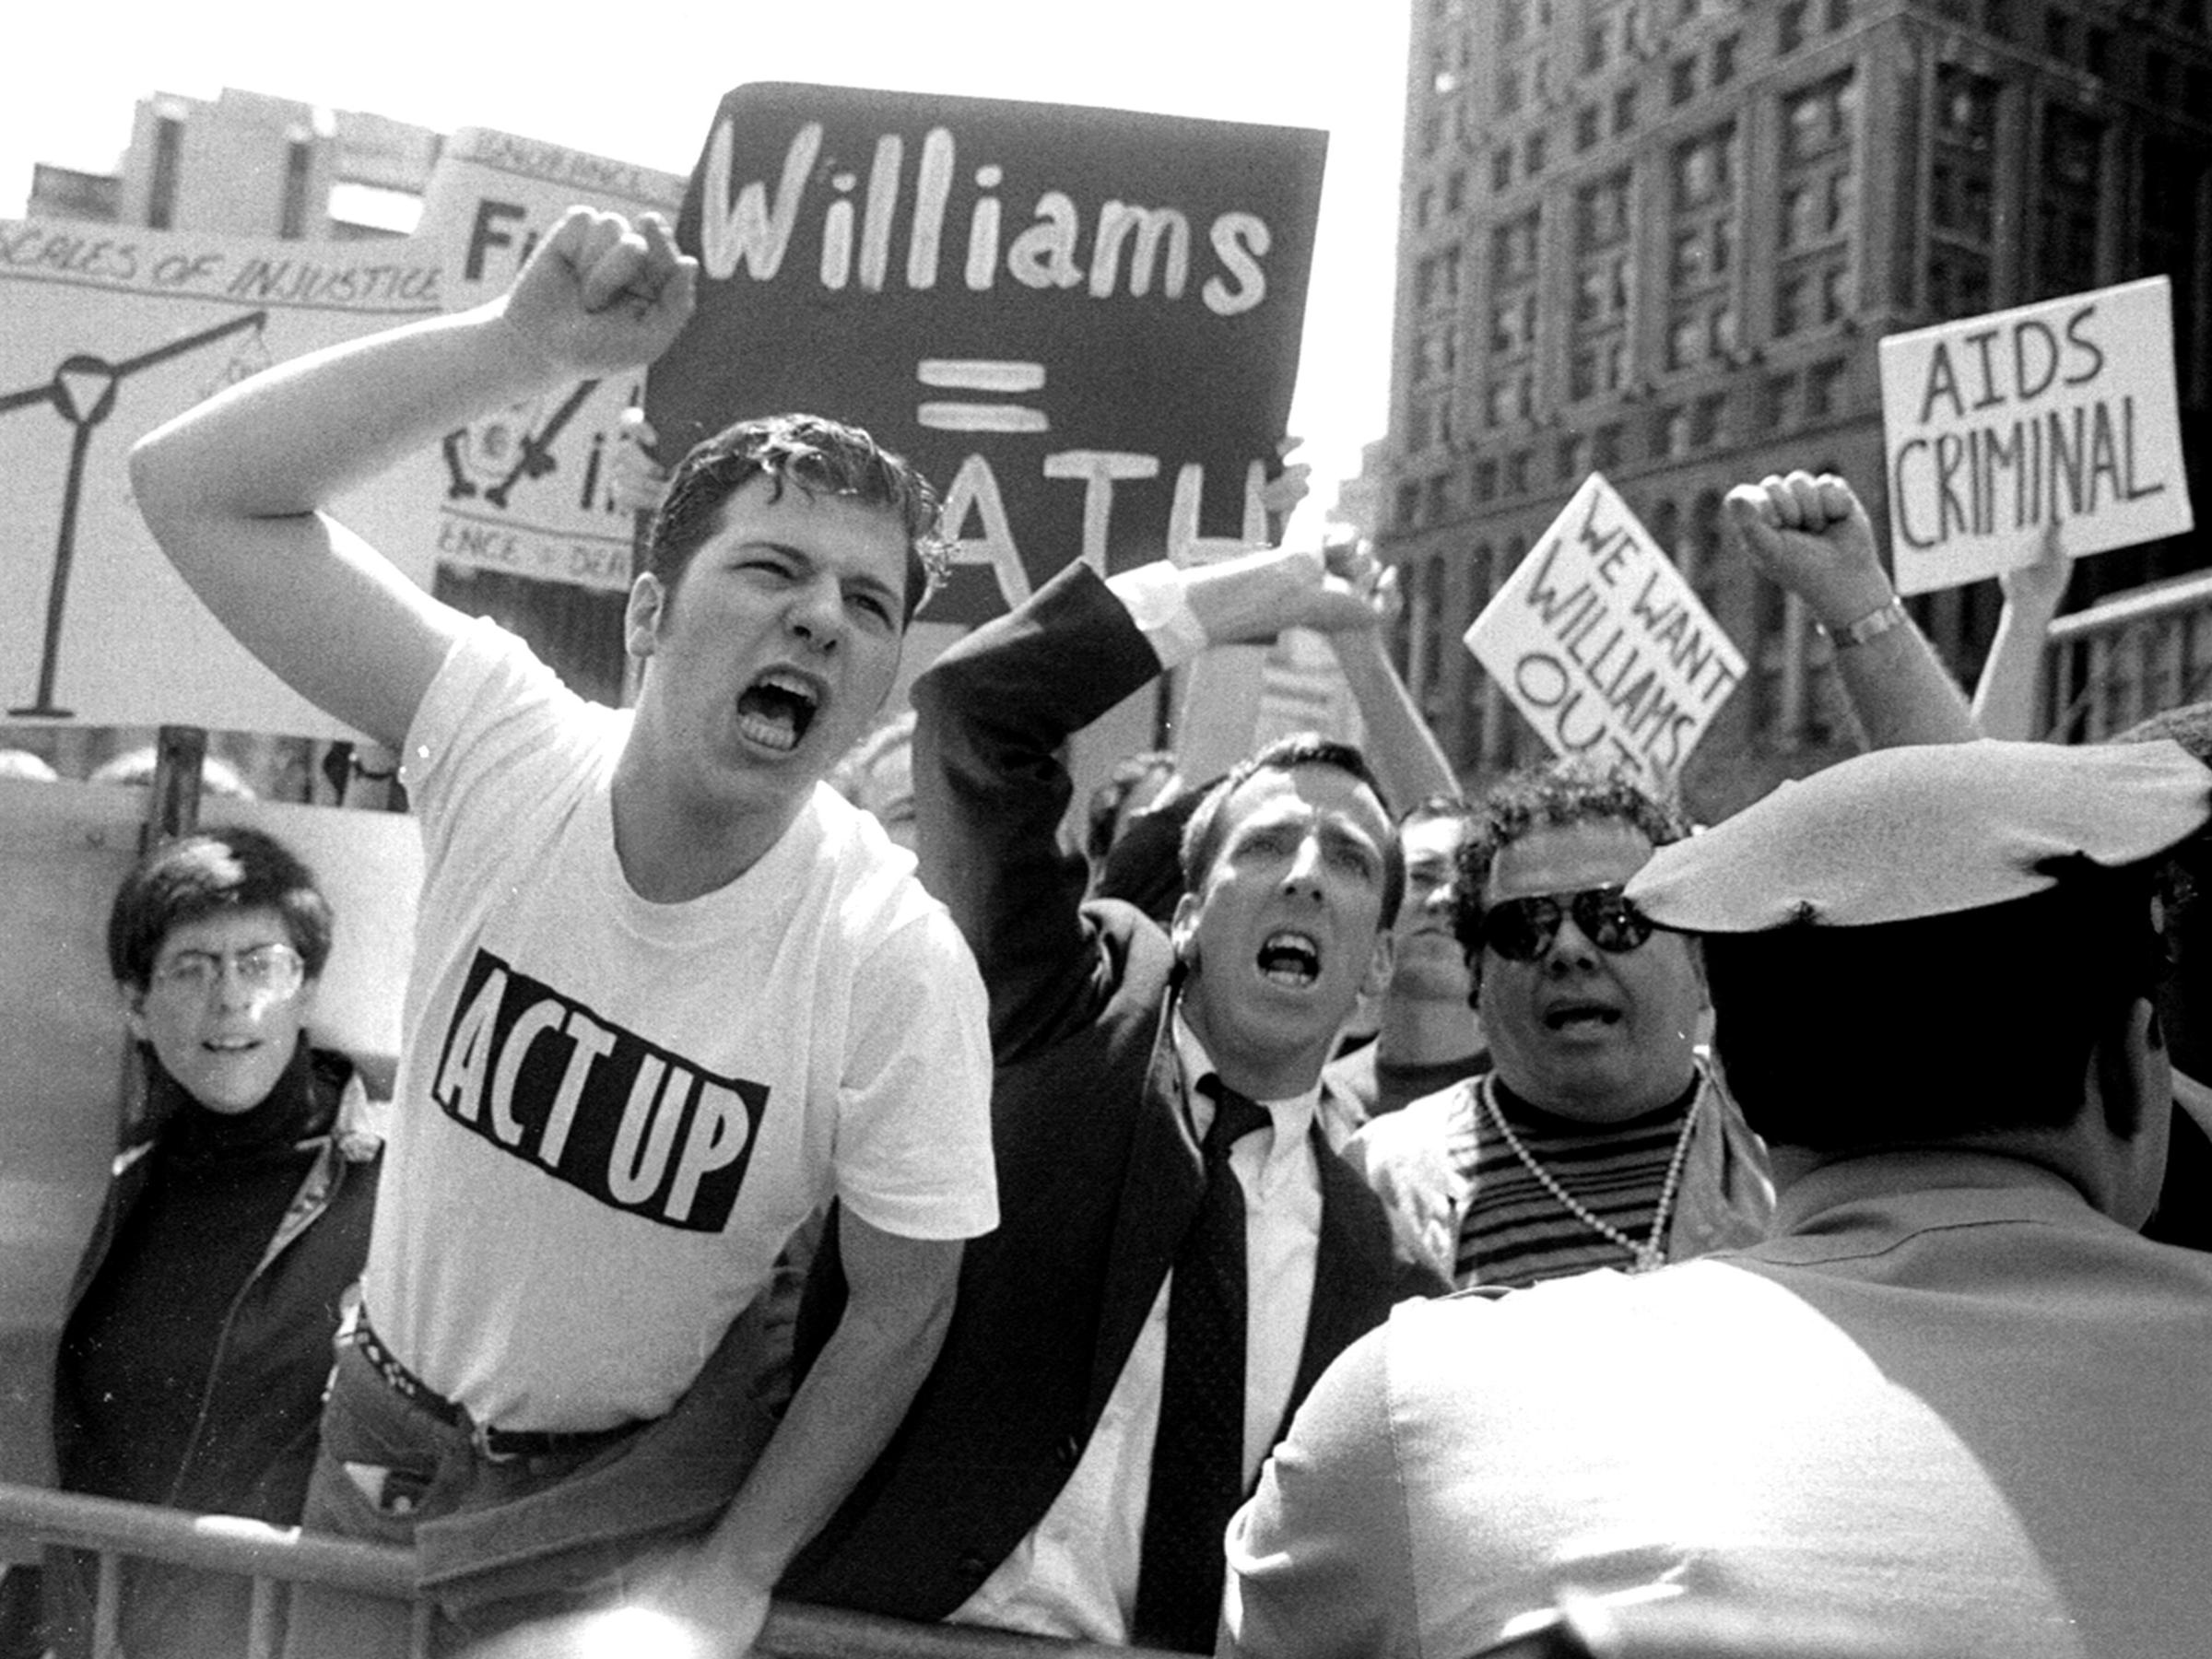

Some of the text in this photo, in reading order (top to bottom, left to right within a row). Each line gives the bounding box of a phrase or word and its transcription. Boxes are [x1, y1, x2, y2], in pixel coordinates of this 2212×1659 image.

[153, 253, 226, 287] OF
[228, 258, 444, 301] INJUSTICE
[701, 115, 1271, 315] Williams
[1920, 305, 2103, 424] AIDS
[438, 521, 519, 565] ENCE
[938, 449, 1269, 612] ATH
[1896, 395, 2166, 549] CRIMINAL
[1526, 538, 1698, 776] WILLIAMS
[1577, 489, 1738, 703] WE WANT
[438, 967, 750, 1223] ACT UP
